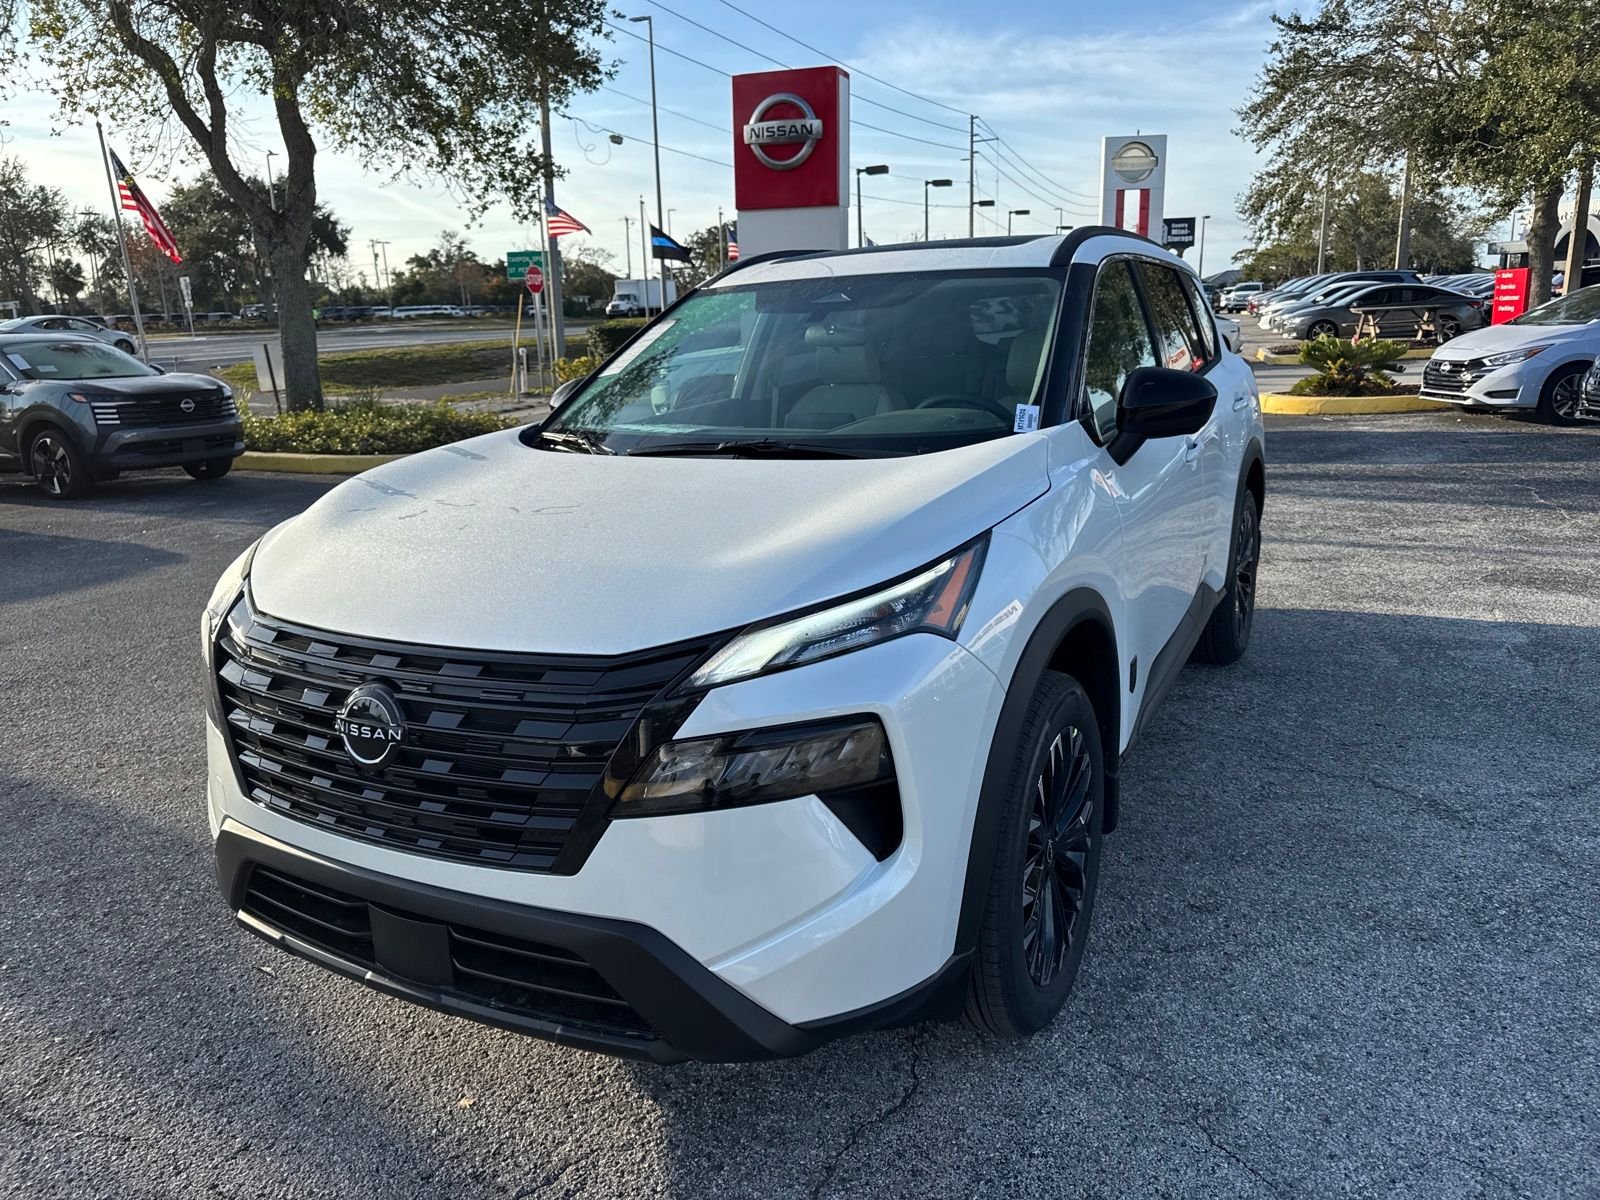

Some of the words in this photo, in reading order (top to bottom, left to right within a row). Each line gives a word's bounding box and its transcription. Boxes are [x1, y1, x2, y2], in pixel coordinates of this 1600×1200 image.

[750, 123, 813, 140] NISSAN
[527, 273, 542, 285] STOP
[337, 719, 401, 741] NISSAN
